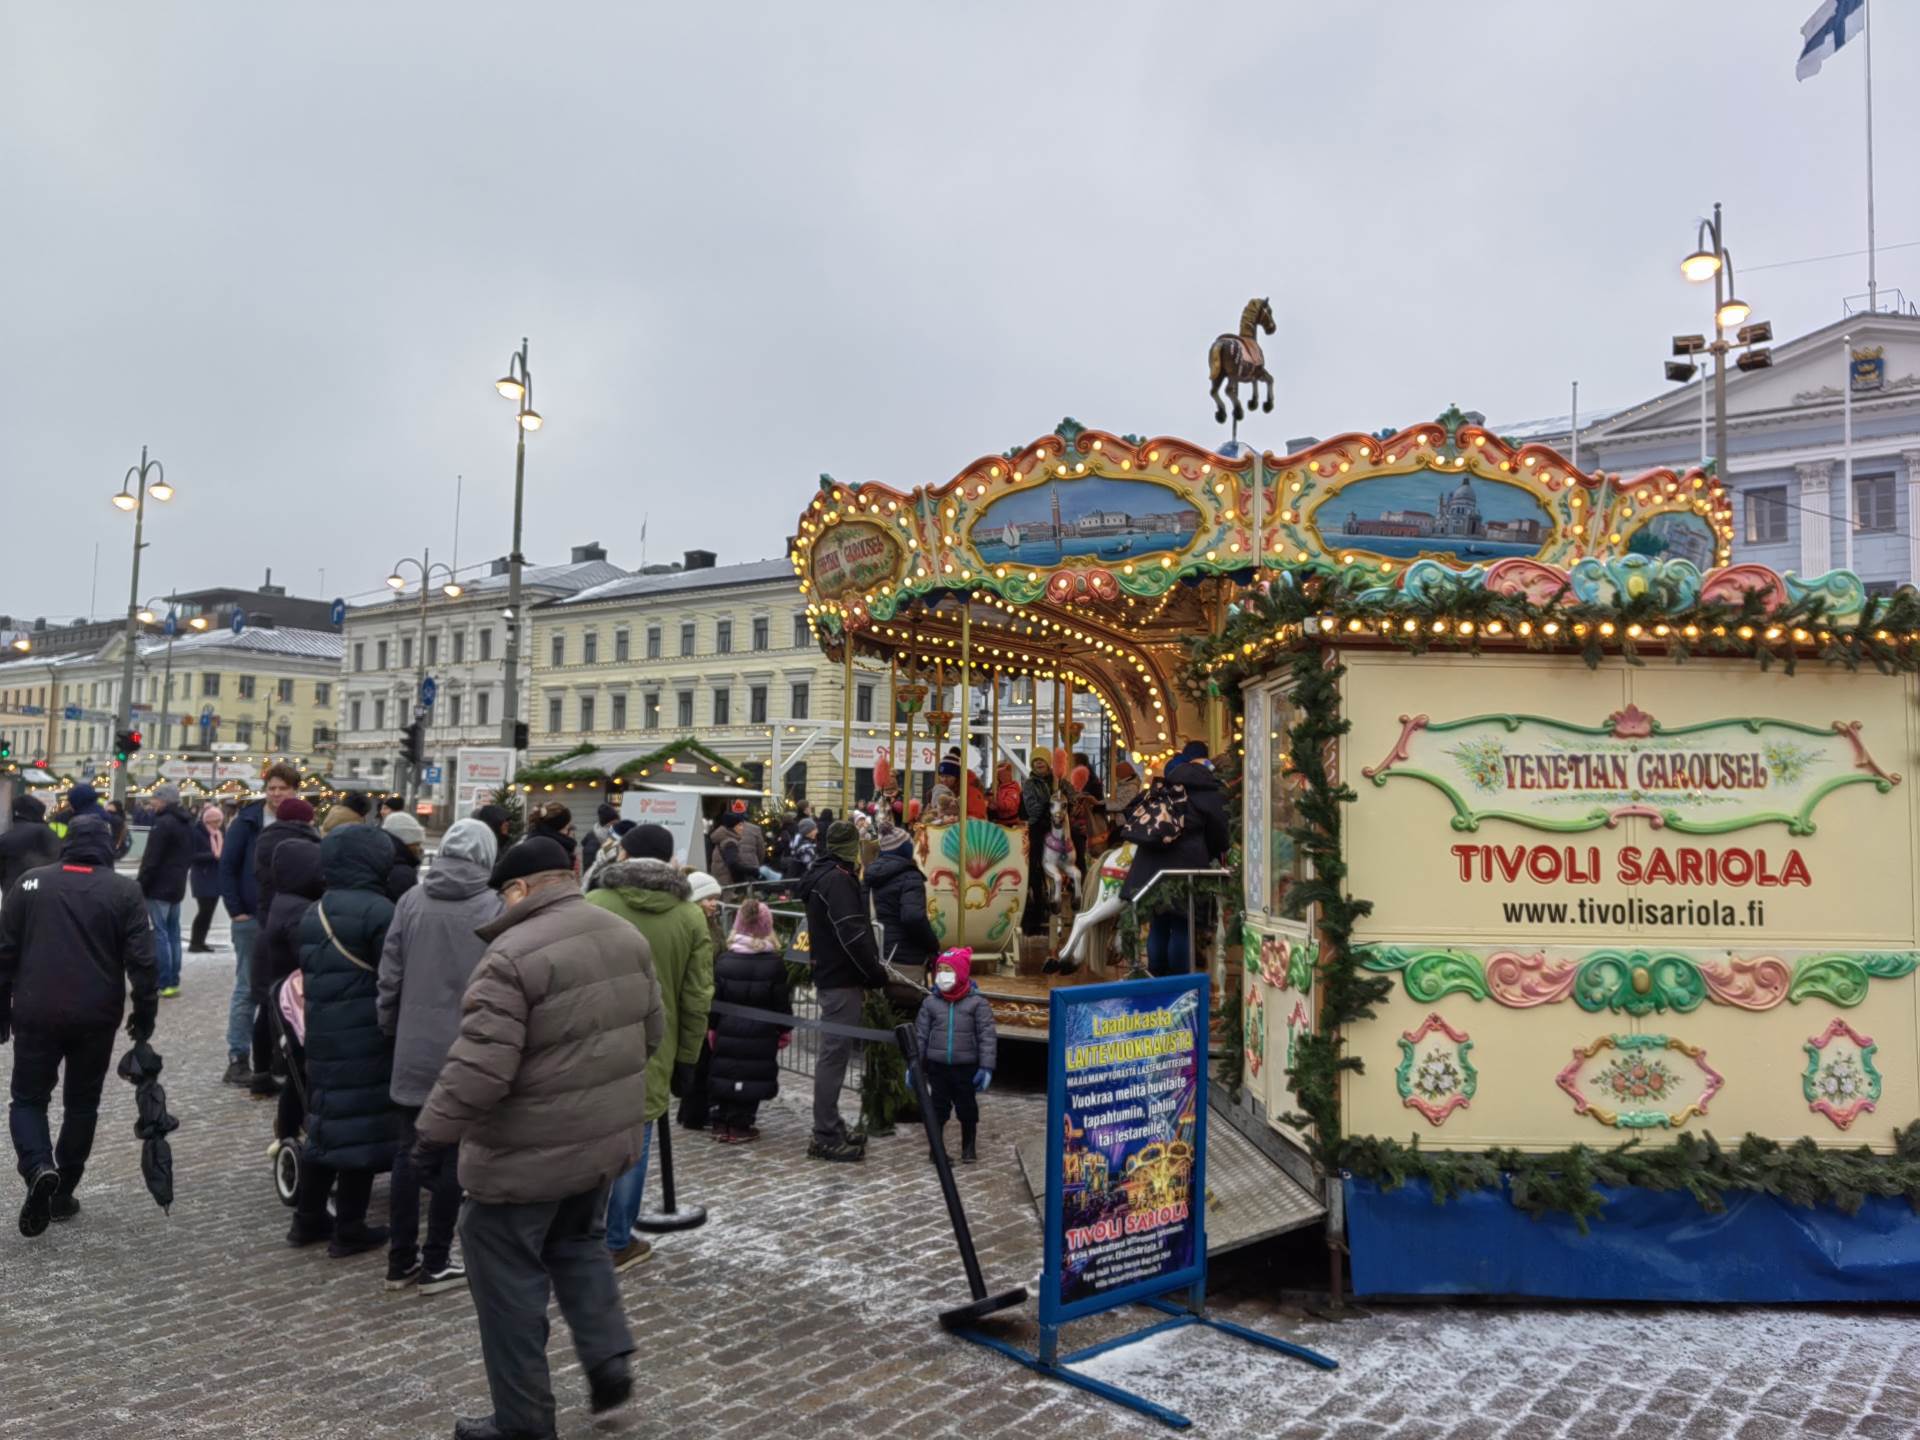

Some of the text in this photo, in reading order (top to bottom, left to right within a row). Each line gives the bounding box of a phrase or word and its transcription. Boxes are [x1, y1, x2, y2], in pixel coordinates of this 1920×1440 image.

[1503, 752, 1768, 790] VENETIAN CAROUSEL
[1451, 844, 1812, 888] TIVOLI SARIOLA
[1502, 898, 1765, 927] www.tivolisariola.fi
[1092, 1006, 1173, 1038] Laadukasta
[1072, 1076, 1187, 1109] Vuokraa meiltä huvilaite
[1098, 1132, 1114, 1147] tai
[1066, 1217, 1123, 1250] TIVOLI
[1124, 1200, 1190, 1234] SARIOLA
